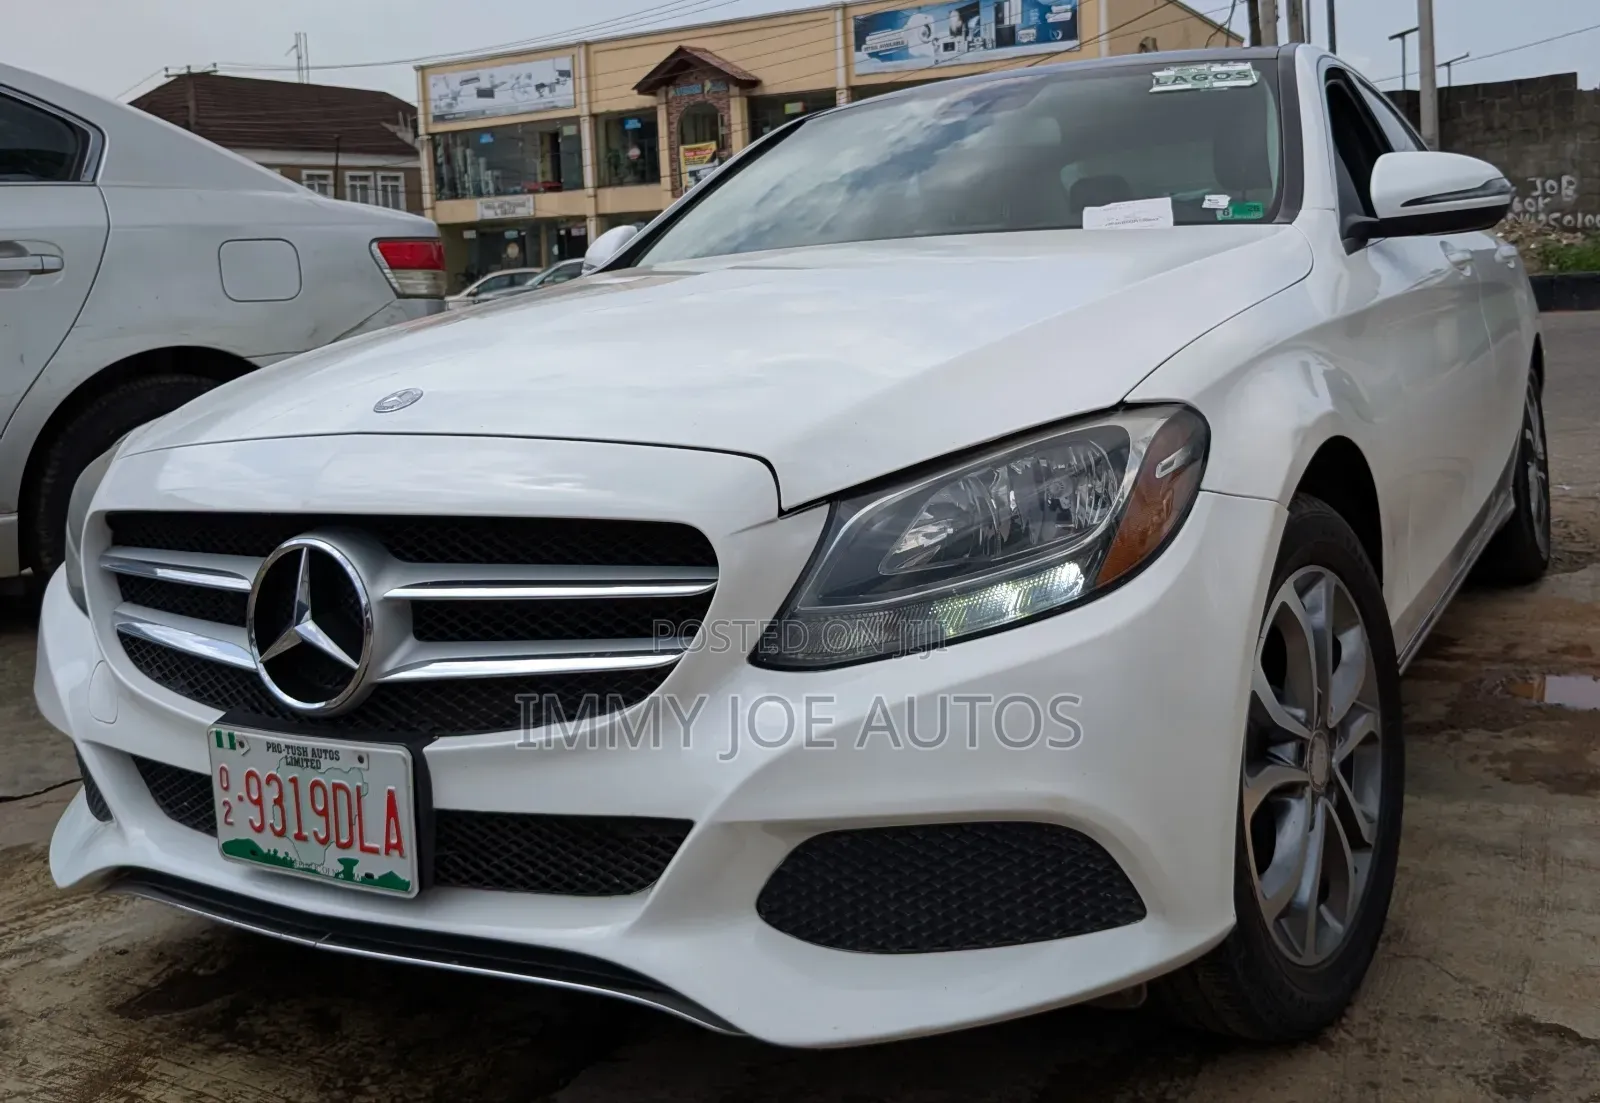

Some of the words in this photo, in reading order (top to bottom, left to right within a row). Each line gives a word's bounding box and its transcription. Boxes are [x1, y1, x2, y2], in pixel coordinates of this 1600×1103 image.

[1155, 71, 1249, 85] LAGOS
[1527, 175, 1577, 201] JOB
[265, 741, 309, 757] PRO-TUSH
[311, 748, 341, 761] AUTOS
[285, 755, 321, 770] LIMITED
